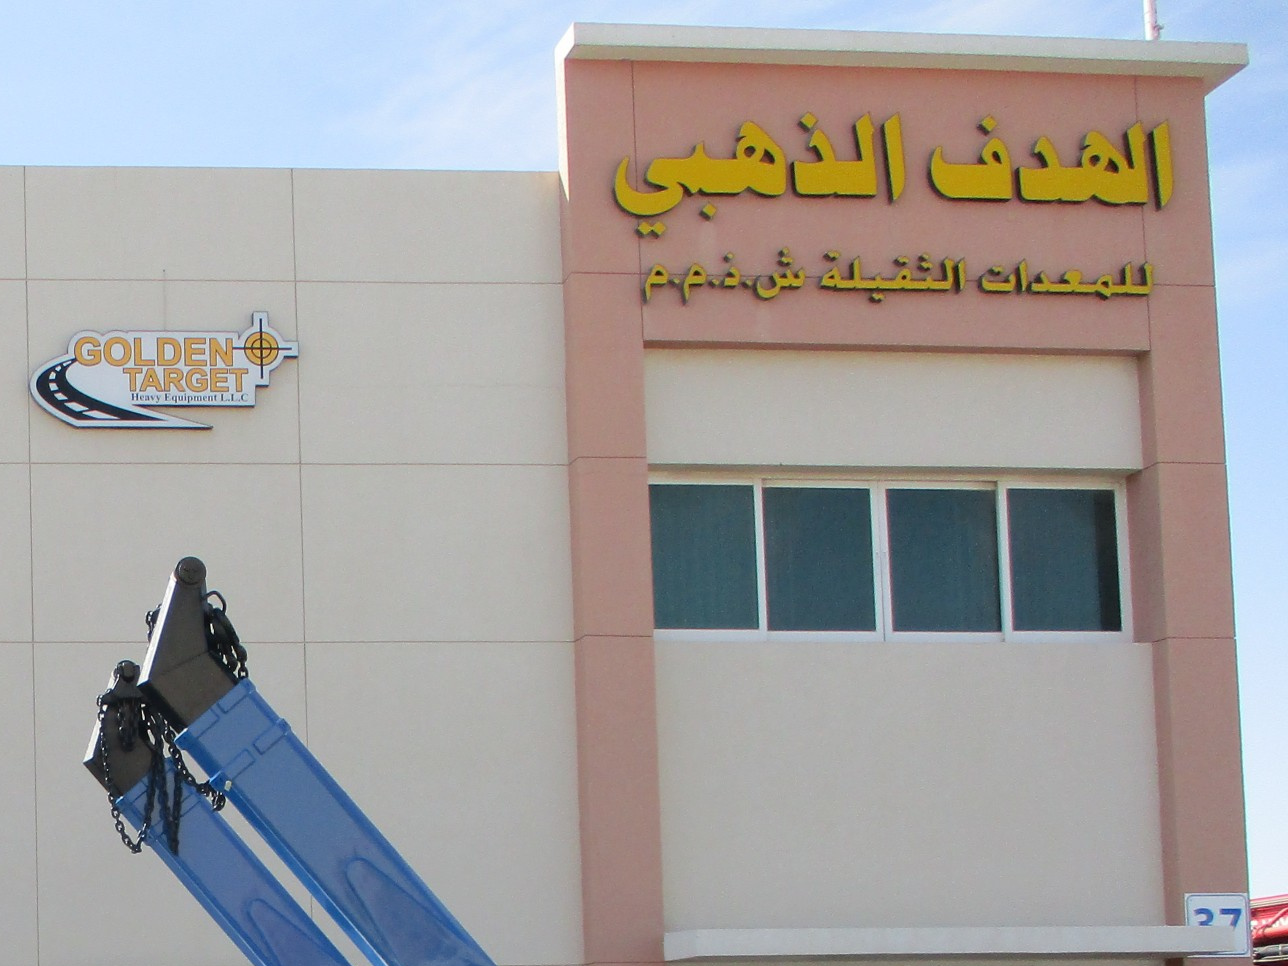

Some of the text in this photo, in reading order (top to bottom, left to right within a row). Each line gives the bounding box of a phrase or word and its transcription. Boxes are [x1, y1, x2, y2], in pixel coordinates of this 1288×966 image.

[614, 111, 1175, 237] الهدف الذهبي
[819, 250, 966, 302] الثقيلة
[977, 258, 1154, 301] للمعدات
[74, 336, 234, 367] GOLDEN
[123, 367, 250, 393] TARGET
[131, 393, 249, 404] Heavy Equipment L.L.C
